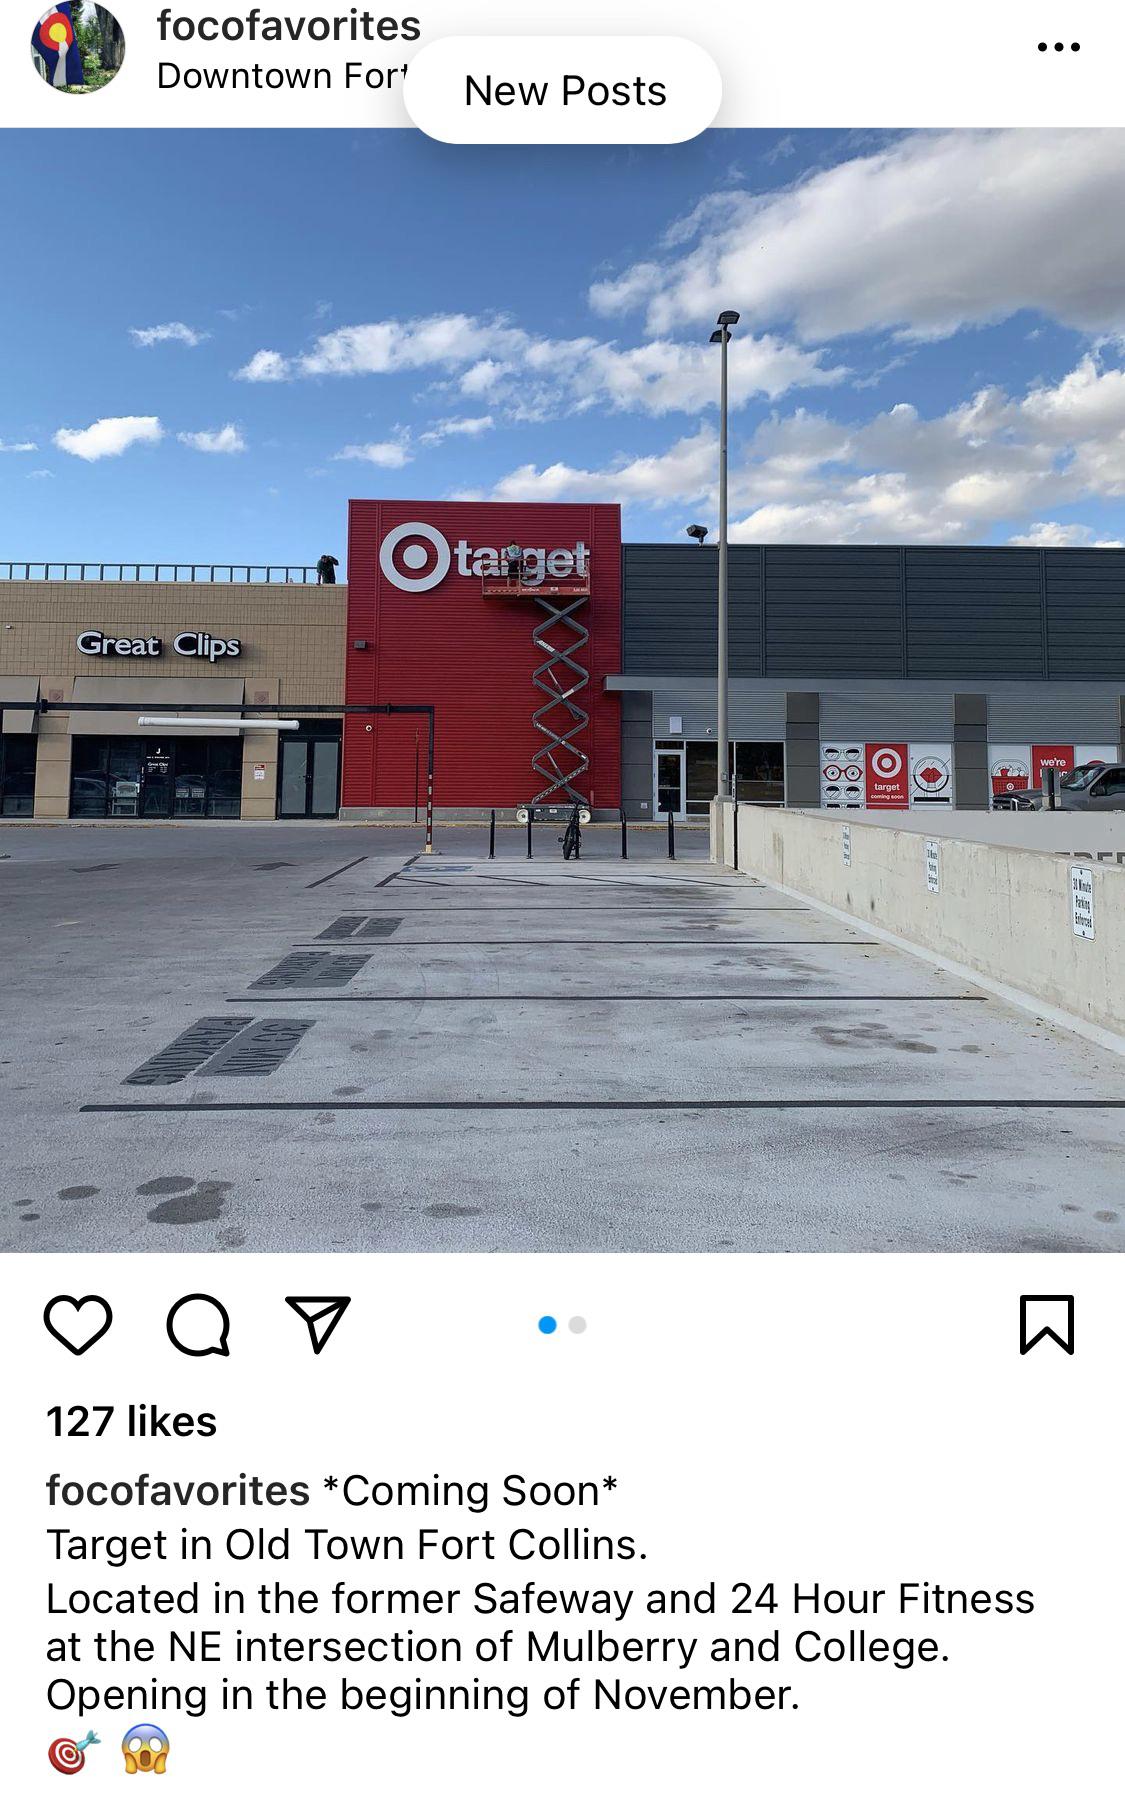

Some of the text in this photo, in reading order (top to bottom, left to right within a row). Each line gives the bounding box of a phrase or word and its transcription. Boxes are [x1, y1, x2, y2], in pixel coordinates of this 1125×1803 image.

[75, 630, 242, 663] Great Clips
[1039, 757, 1067, 767] we're
[873, 782, 901, 793] target
[1078, 878, 1092, 894] Minute
[1075, 894, 1091, 914] Parking
[1075, 911, 1093, 928] Enforced
